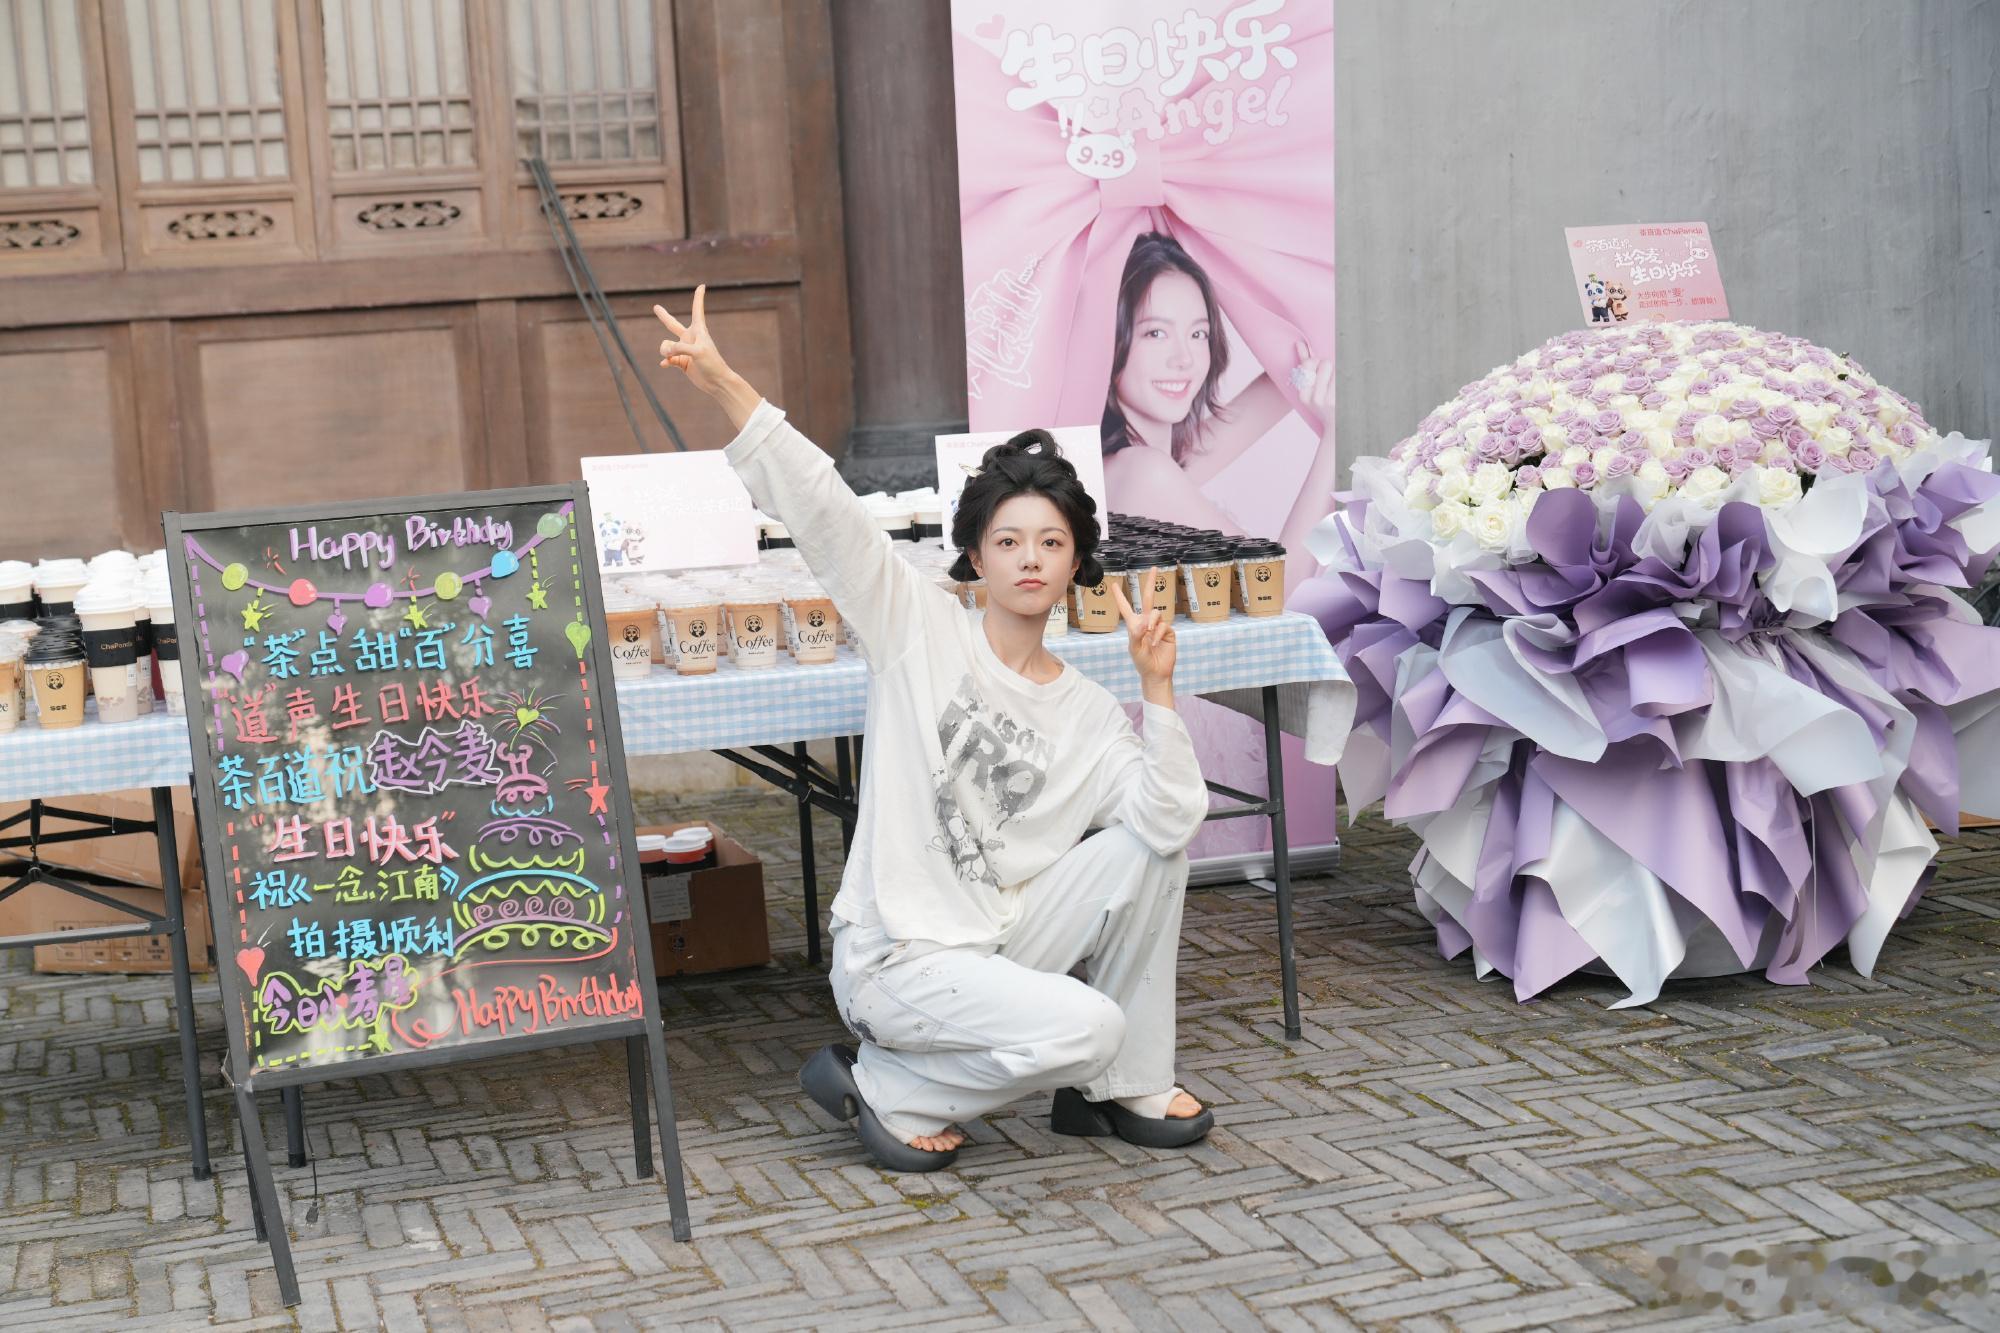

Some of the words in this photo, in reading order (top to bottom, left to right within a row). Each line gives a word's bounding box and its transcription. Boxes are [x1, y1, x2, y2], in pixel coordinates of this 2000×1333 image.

[1001, 0, 1298, 111] 生日快乐
[1116, 75, 1293, 146] Angel
[1076, 145, 1126, 169] 9.29
[1630, 258, 1702, 286] 生日快乐
[289, 526, 395, 570] Happy
[405, 514, 514, 552] Birthday
[679, 639, 716, 655] Coffee
[736, 634, 774, 650] Coffee
[798, 629, 834, 645] Coffee
[613, 644, 649, 660] Coffee
[287, 916, 456, 959] 拍摄顺利
[452, 984, 539, 1036] Happy
[539, 972, 645, 1026] Birthday
